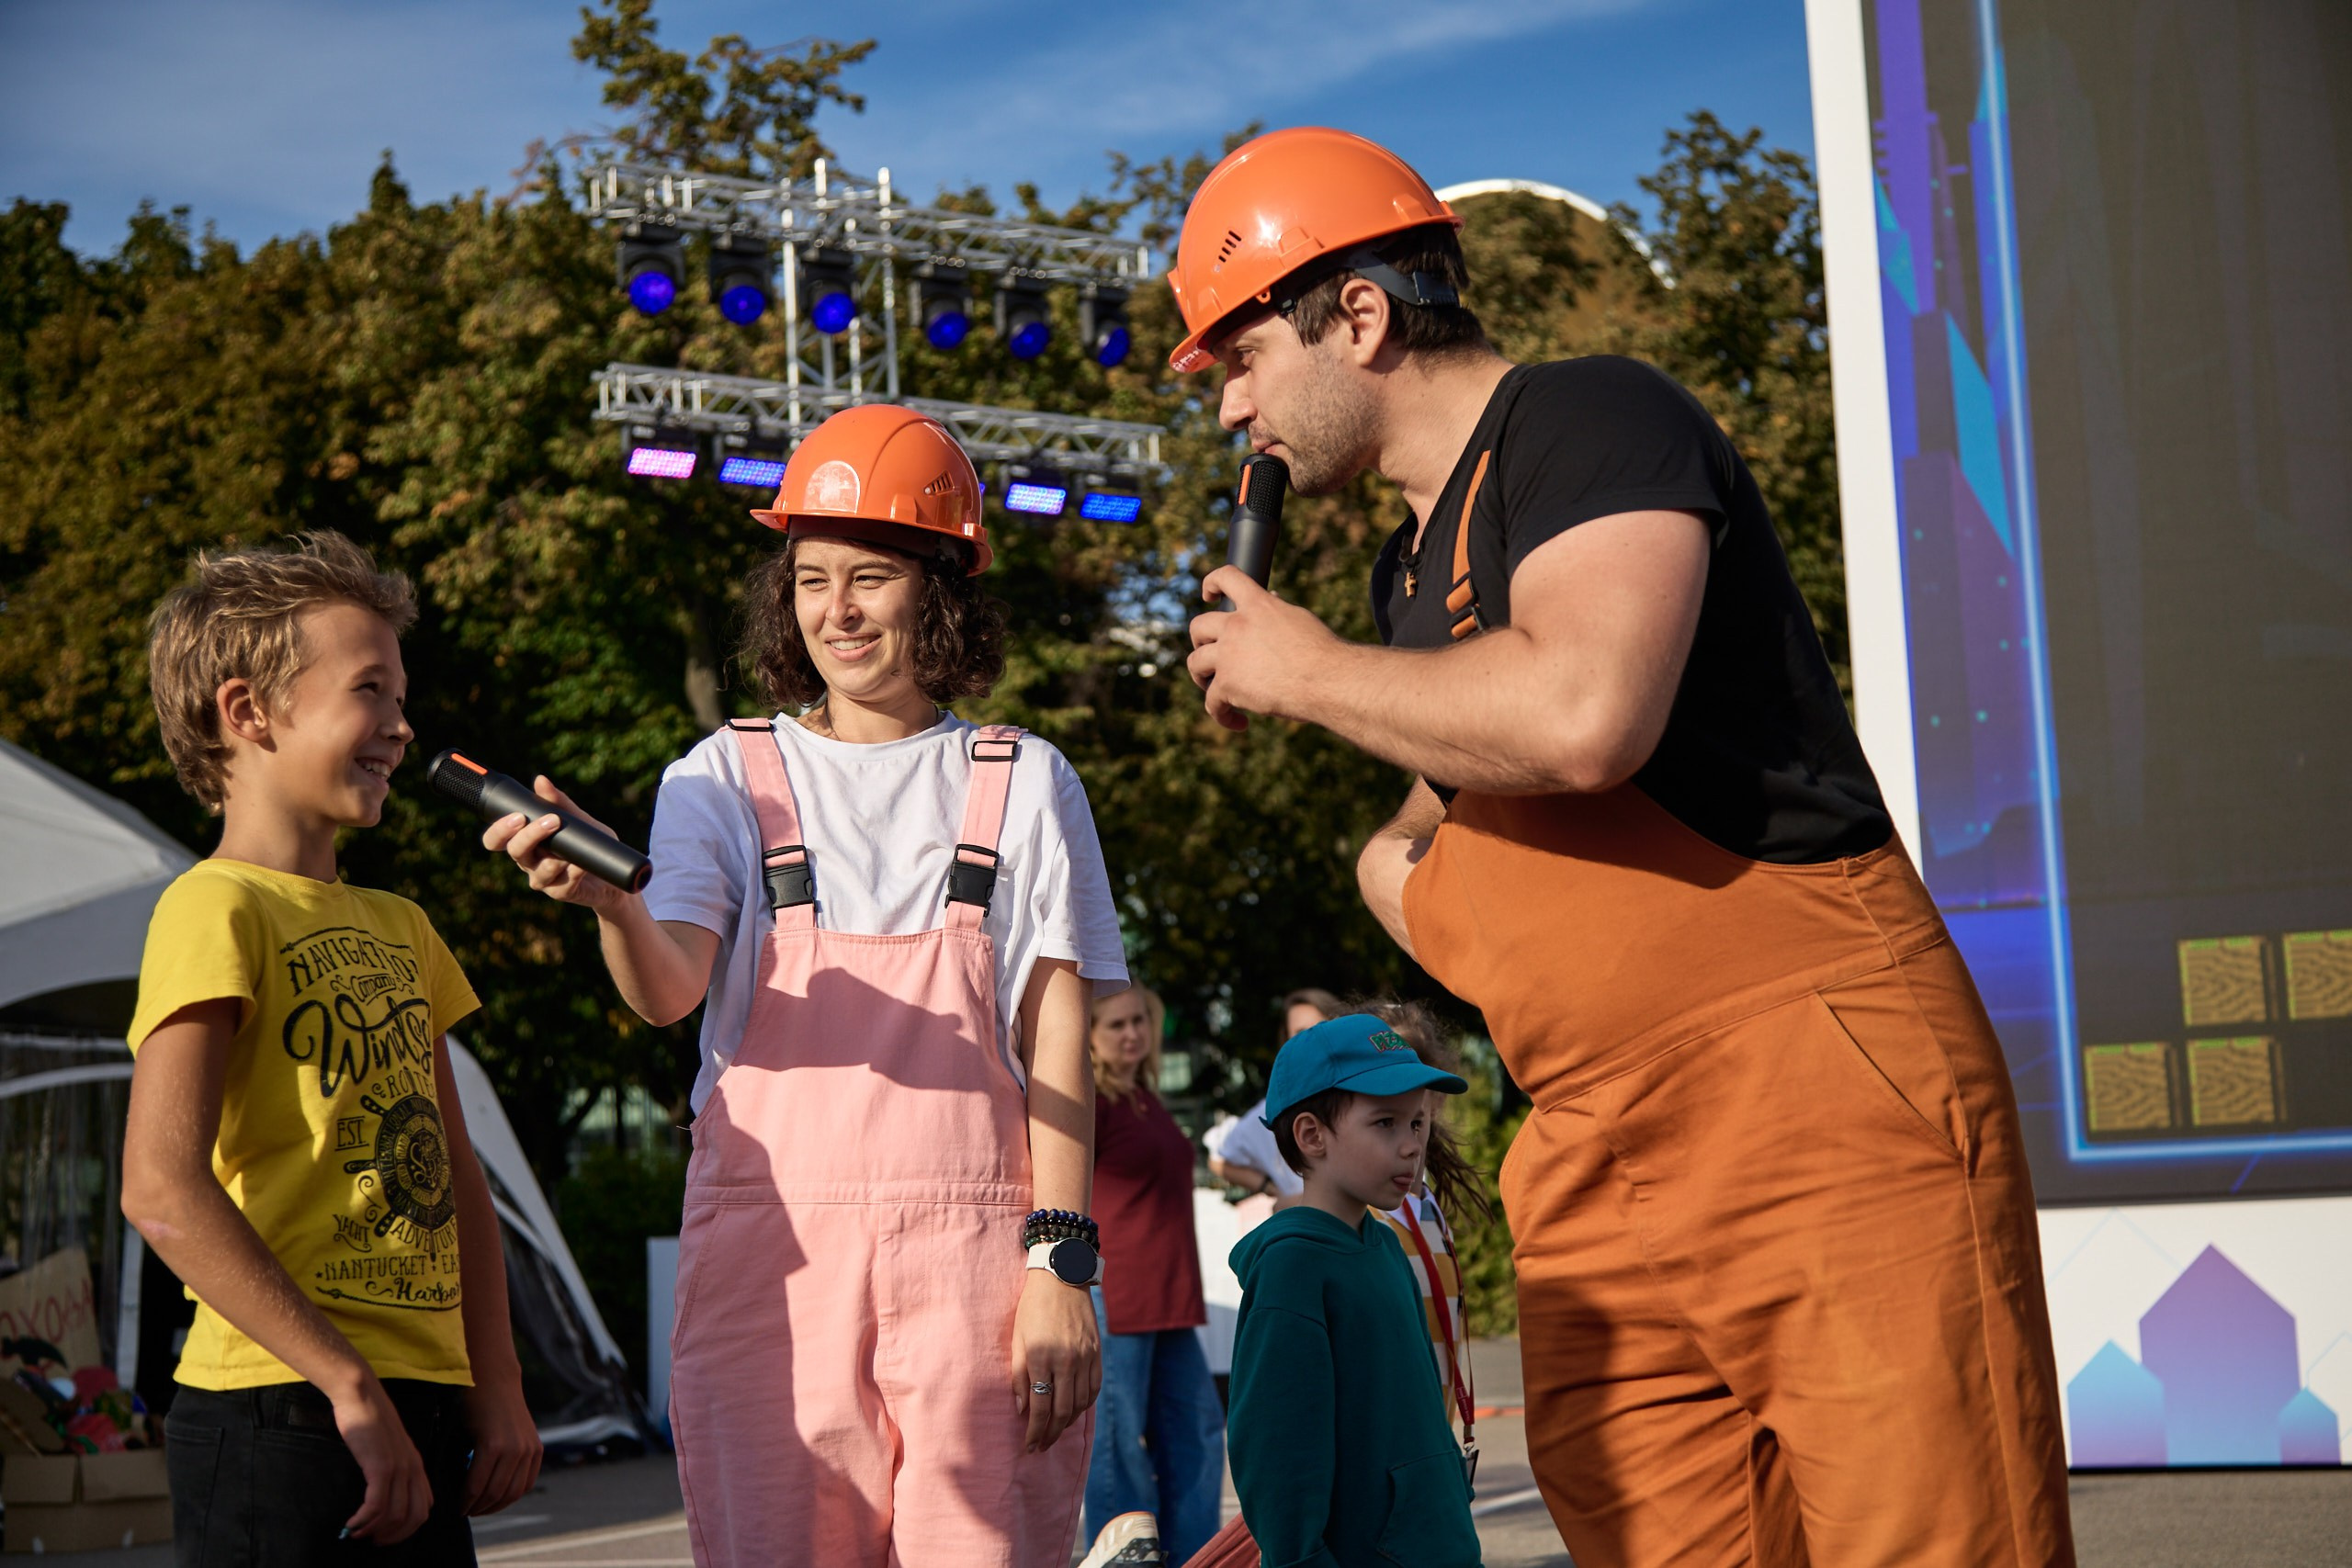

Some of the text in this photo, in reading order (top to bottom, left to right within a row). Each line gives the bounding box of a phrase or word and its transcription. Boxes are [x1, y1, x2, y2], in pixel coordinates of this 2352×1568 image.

[350, 974, 397, 1004] Company
[385, 1068, 435, 1100] ROTE
[333, 1213, 369, 1243] YACHT
[323, 1254, 426, 1281] NANTUCKET
